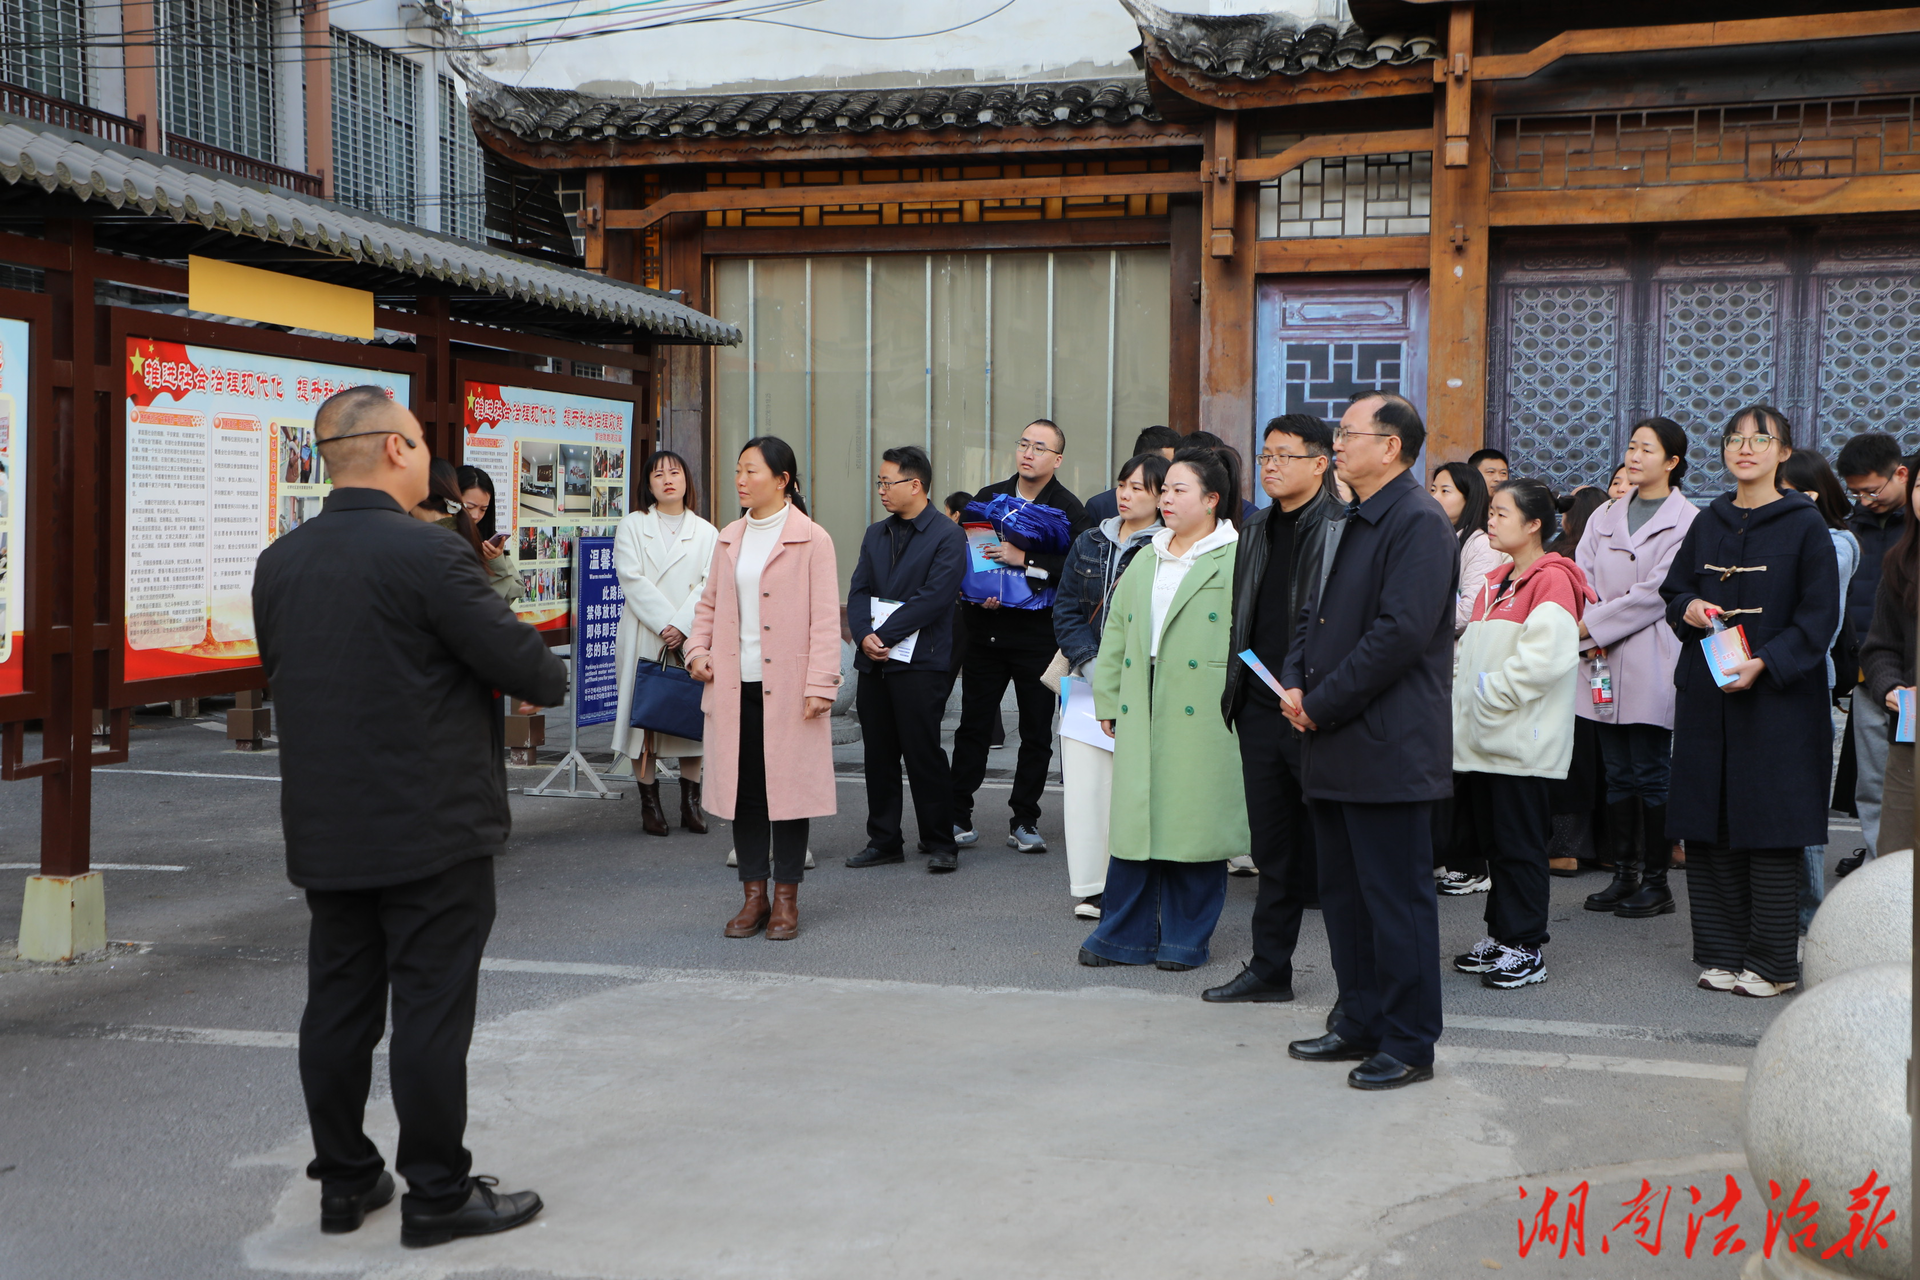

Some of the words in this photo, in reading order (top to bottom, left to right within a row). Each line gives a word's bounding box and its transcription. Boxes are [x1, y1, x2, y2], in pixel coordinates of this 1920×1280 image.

[144, 358, 284, 401] 推进社会治理现代化
